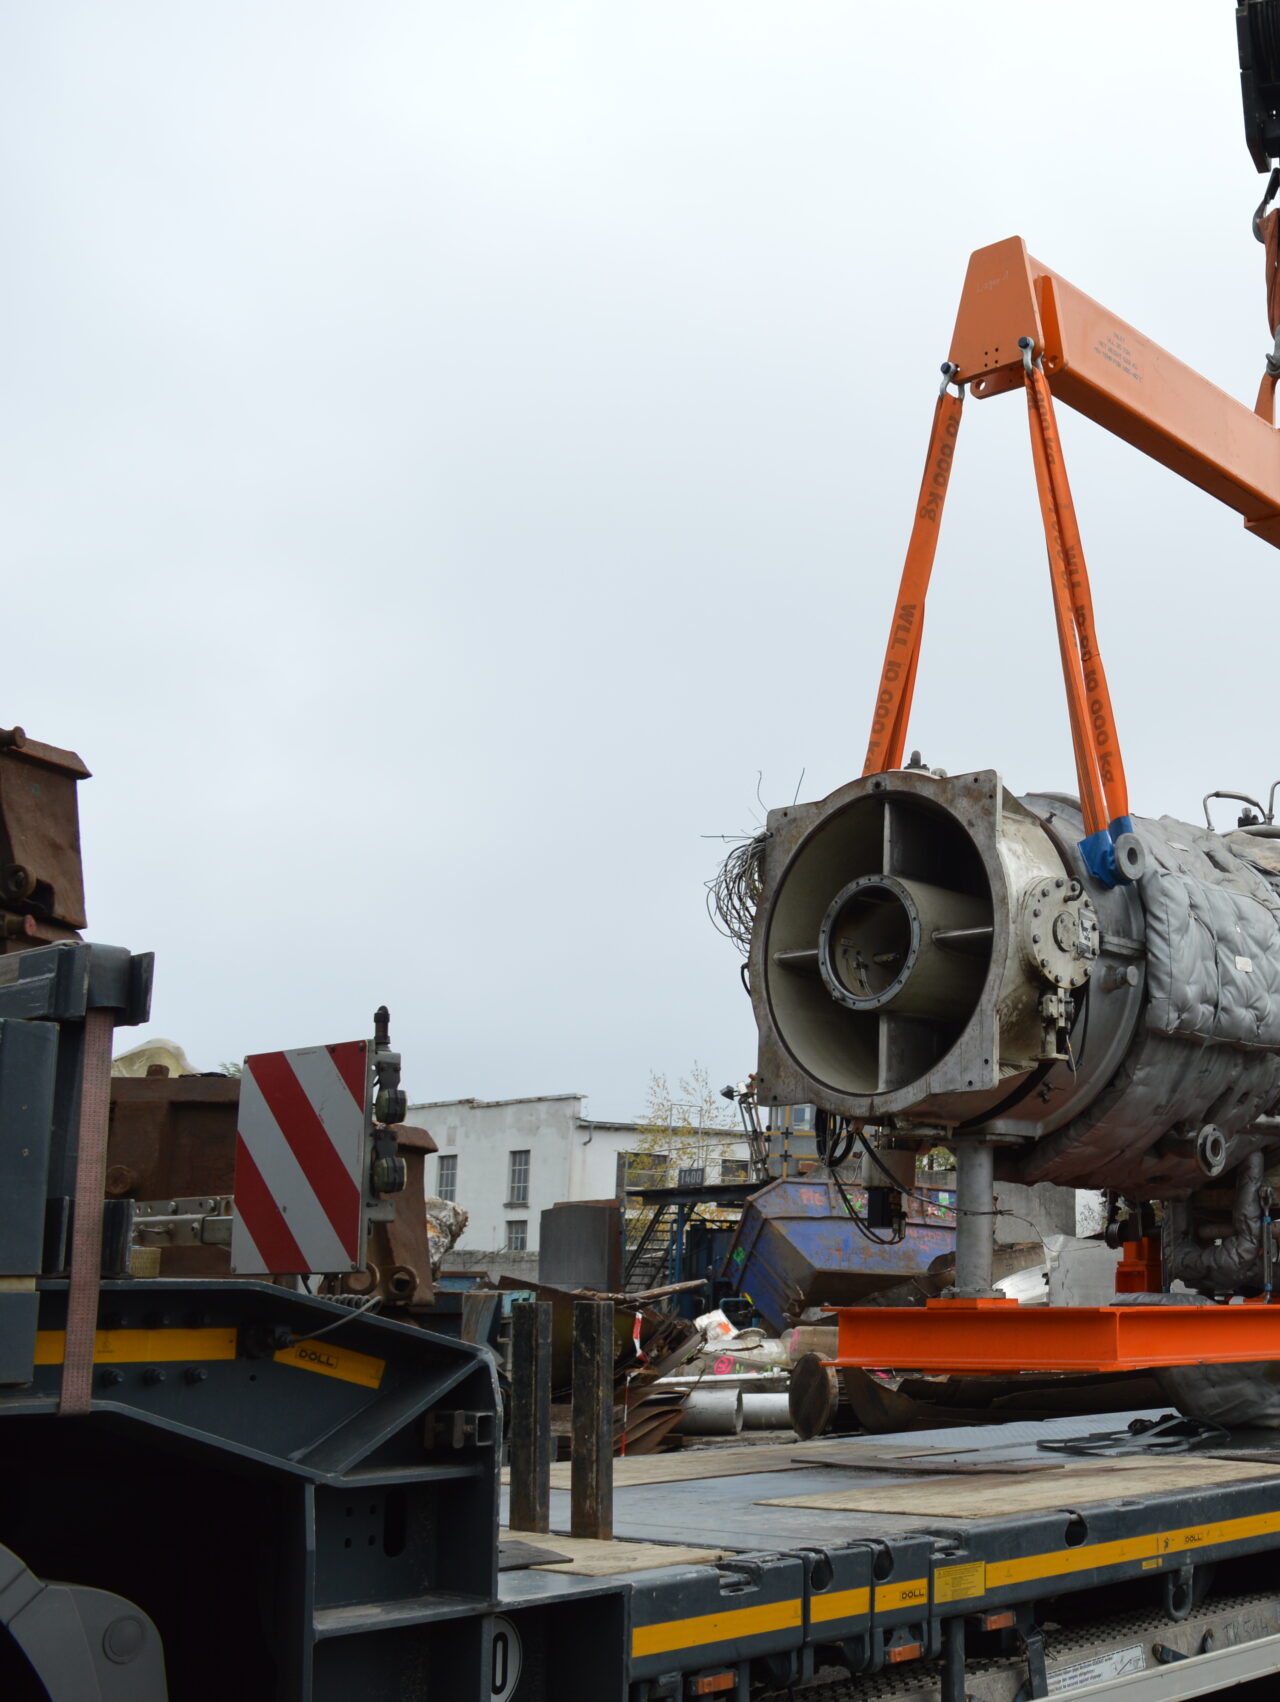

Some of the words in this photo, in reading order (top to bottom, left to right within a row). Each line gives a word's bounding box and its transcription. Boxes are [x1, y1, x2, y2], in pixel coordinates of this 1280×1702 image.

[933, 442, 953, 487] 000
[919, 491, 943, 523] kg
[891, 603, 917, 650] WLL
[884, 660, 902, 683] 10
[872, 690, 894, 735] 000
[1090, 700, 1109, 746] 000
[1100, 751, 1114, 786] kg
[299, 1348, 334, 1368] DOLL
[1184, 1534, 1203, 1544] DOLL
[901, 1589, 925, 1600] DOLL
